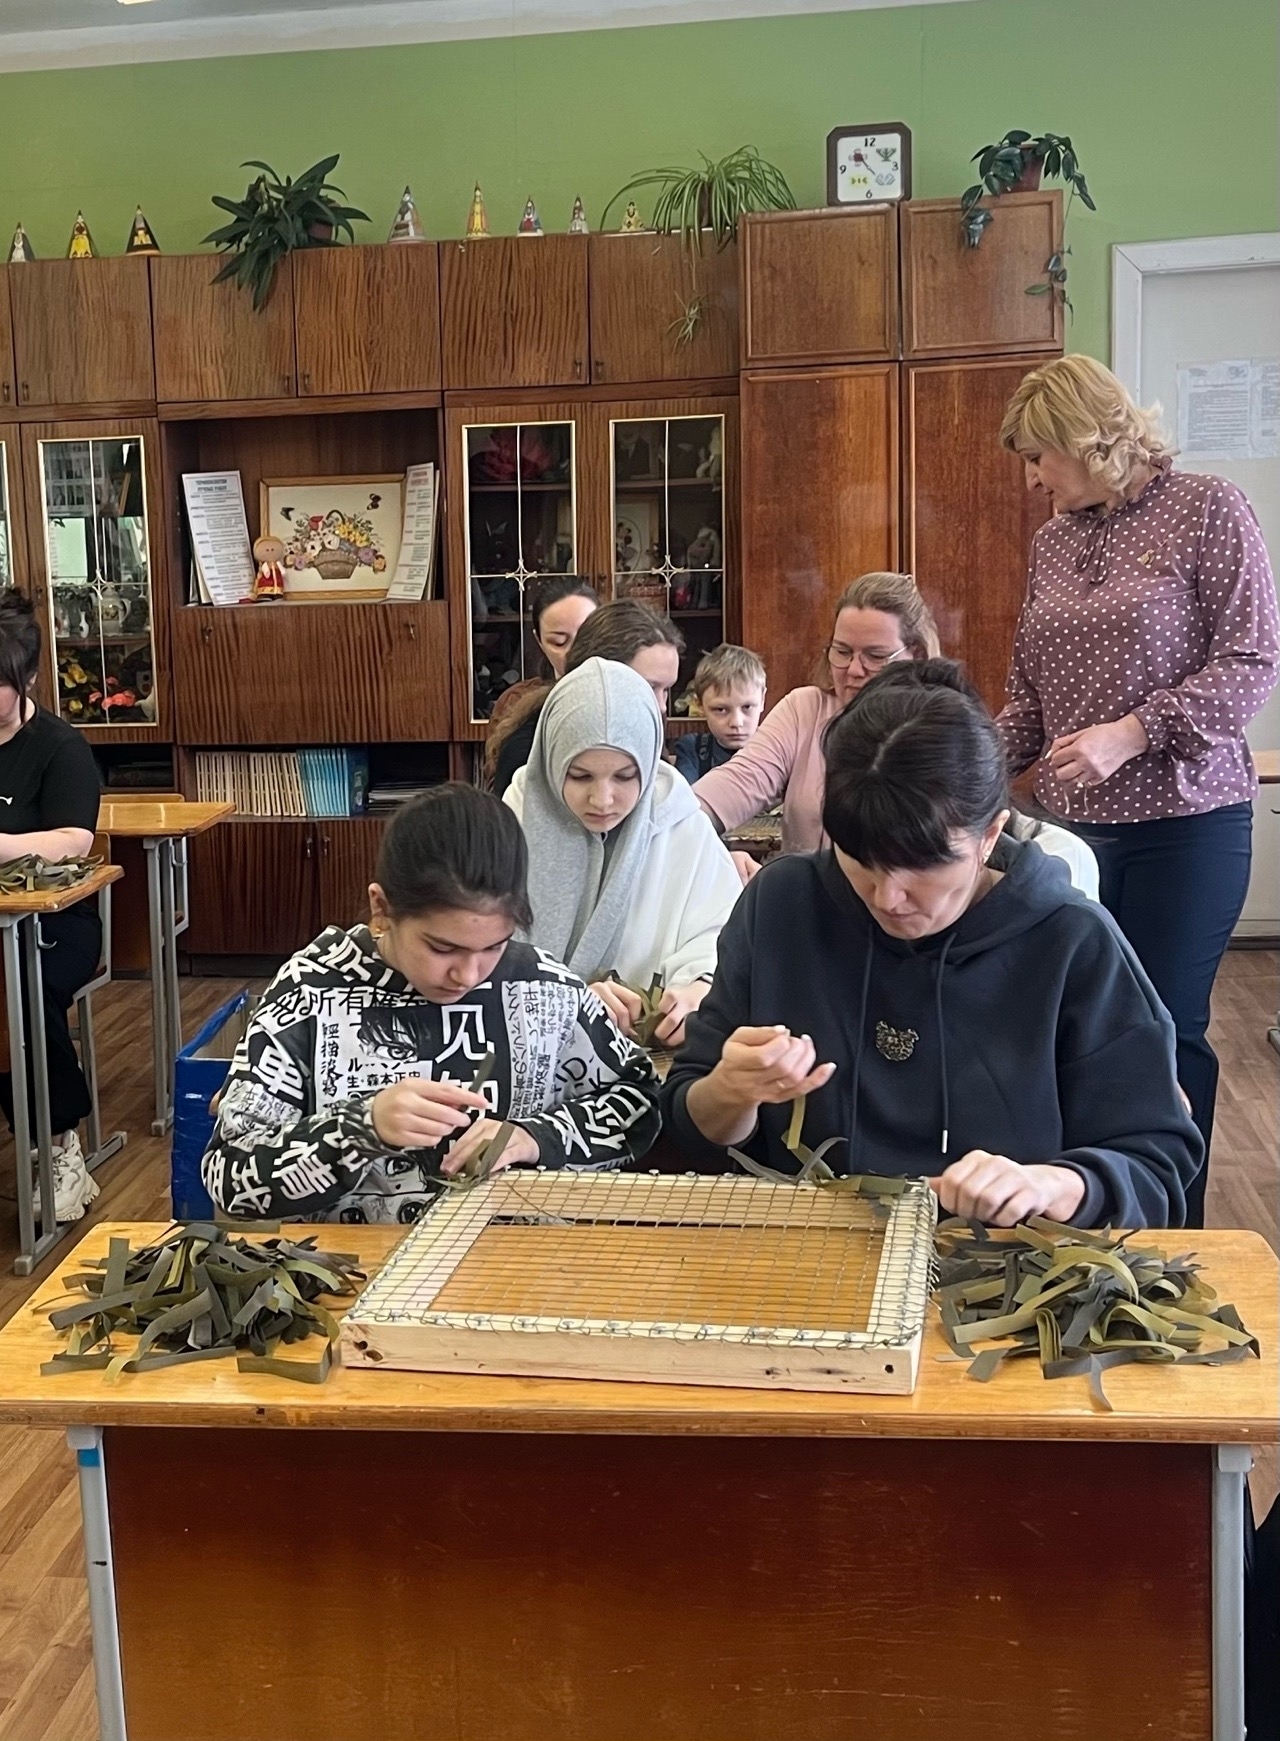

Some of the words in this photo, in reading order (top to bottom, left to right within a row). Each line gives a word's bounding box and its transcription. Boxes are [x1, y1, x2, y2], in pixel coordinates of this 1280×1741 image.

[864, 137, 876, 147] 12
[839, 165, 847, 175] 9
[892, 161, 899, 171] 3
[865, 189, 873, 199] 6
